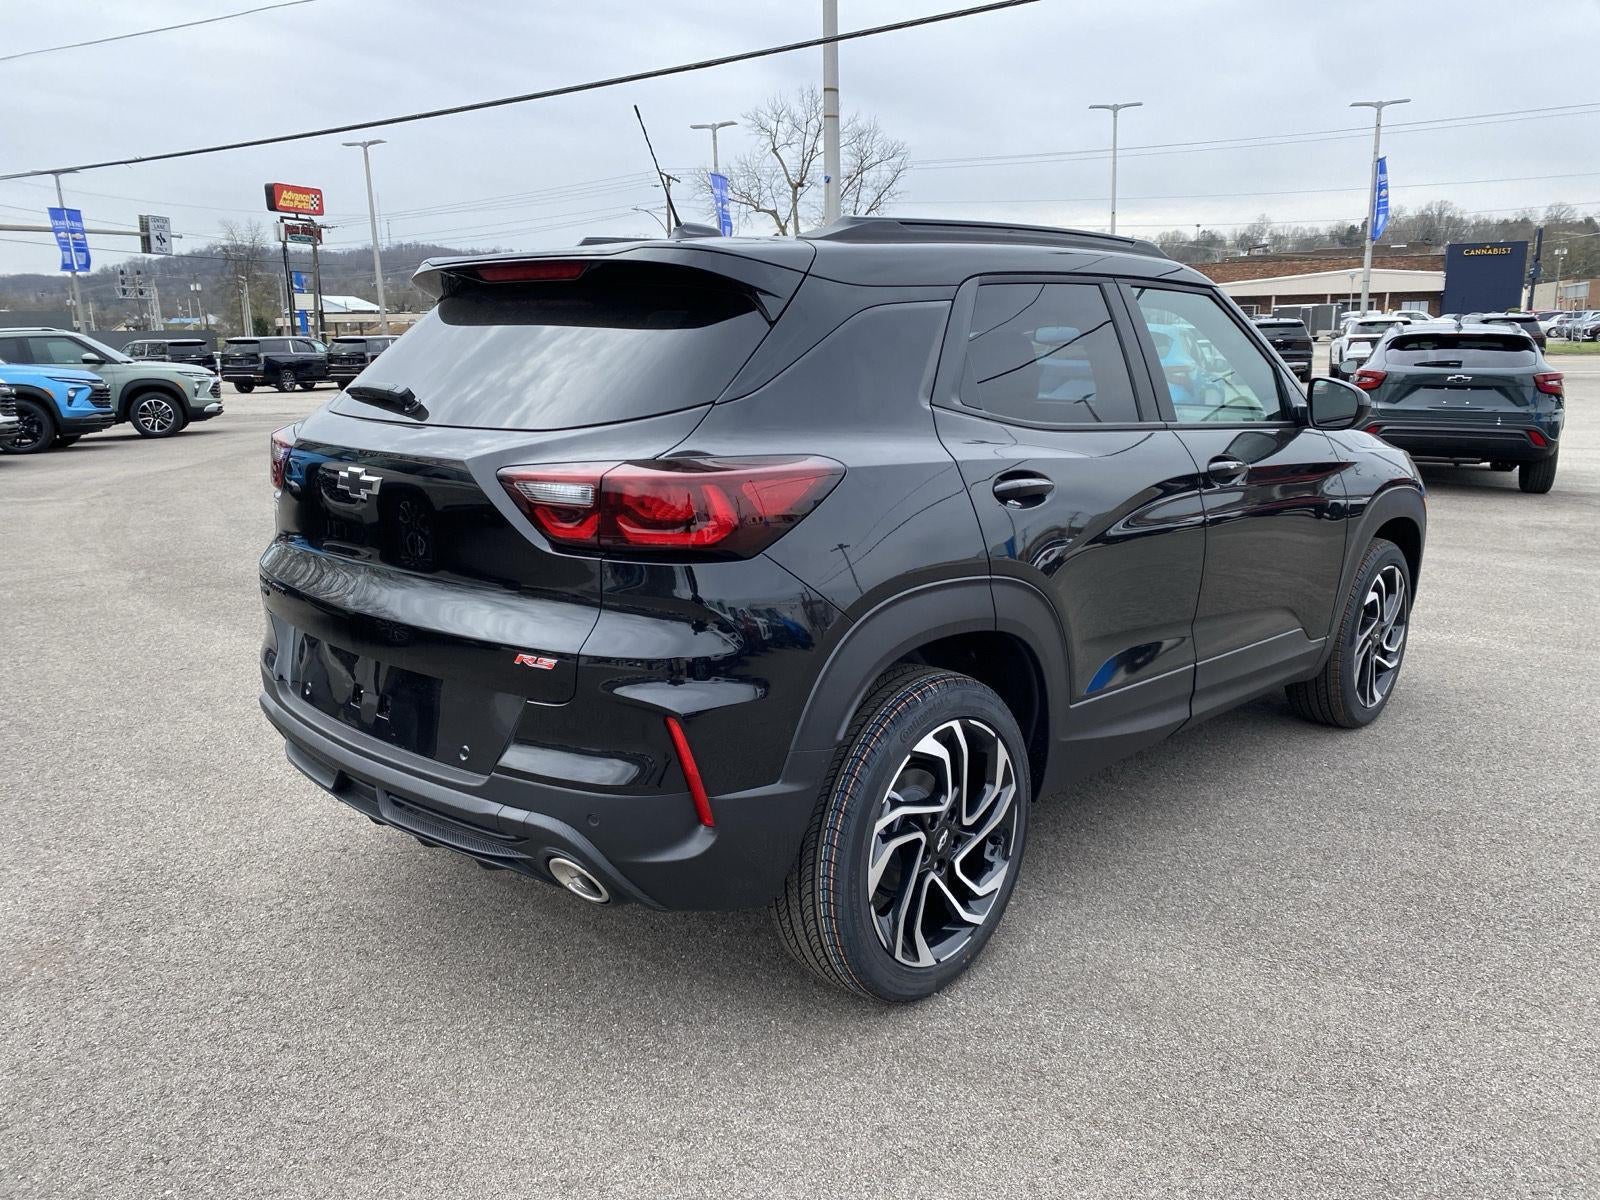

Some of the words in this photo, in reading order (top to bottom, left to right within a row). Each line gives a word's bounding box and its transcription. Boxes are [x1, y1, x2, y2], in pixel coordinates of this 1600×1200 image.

[282, 190, 310, 202] Advance
[279, 199, 294, 207] Auto
[294, 200, 310, 209] Parts
[1463, 247, 1511, 255] CANNABIST
[514, 653, 558, 670] RS
